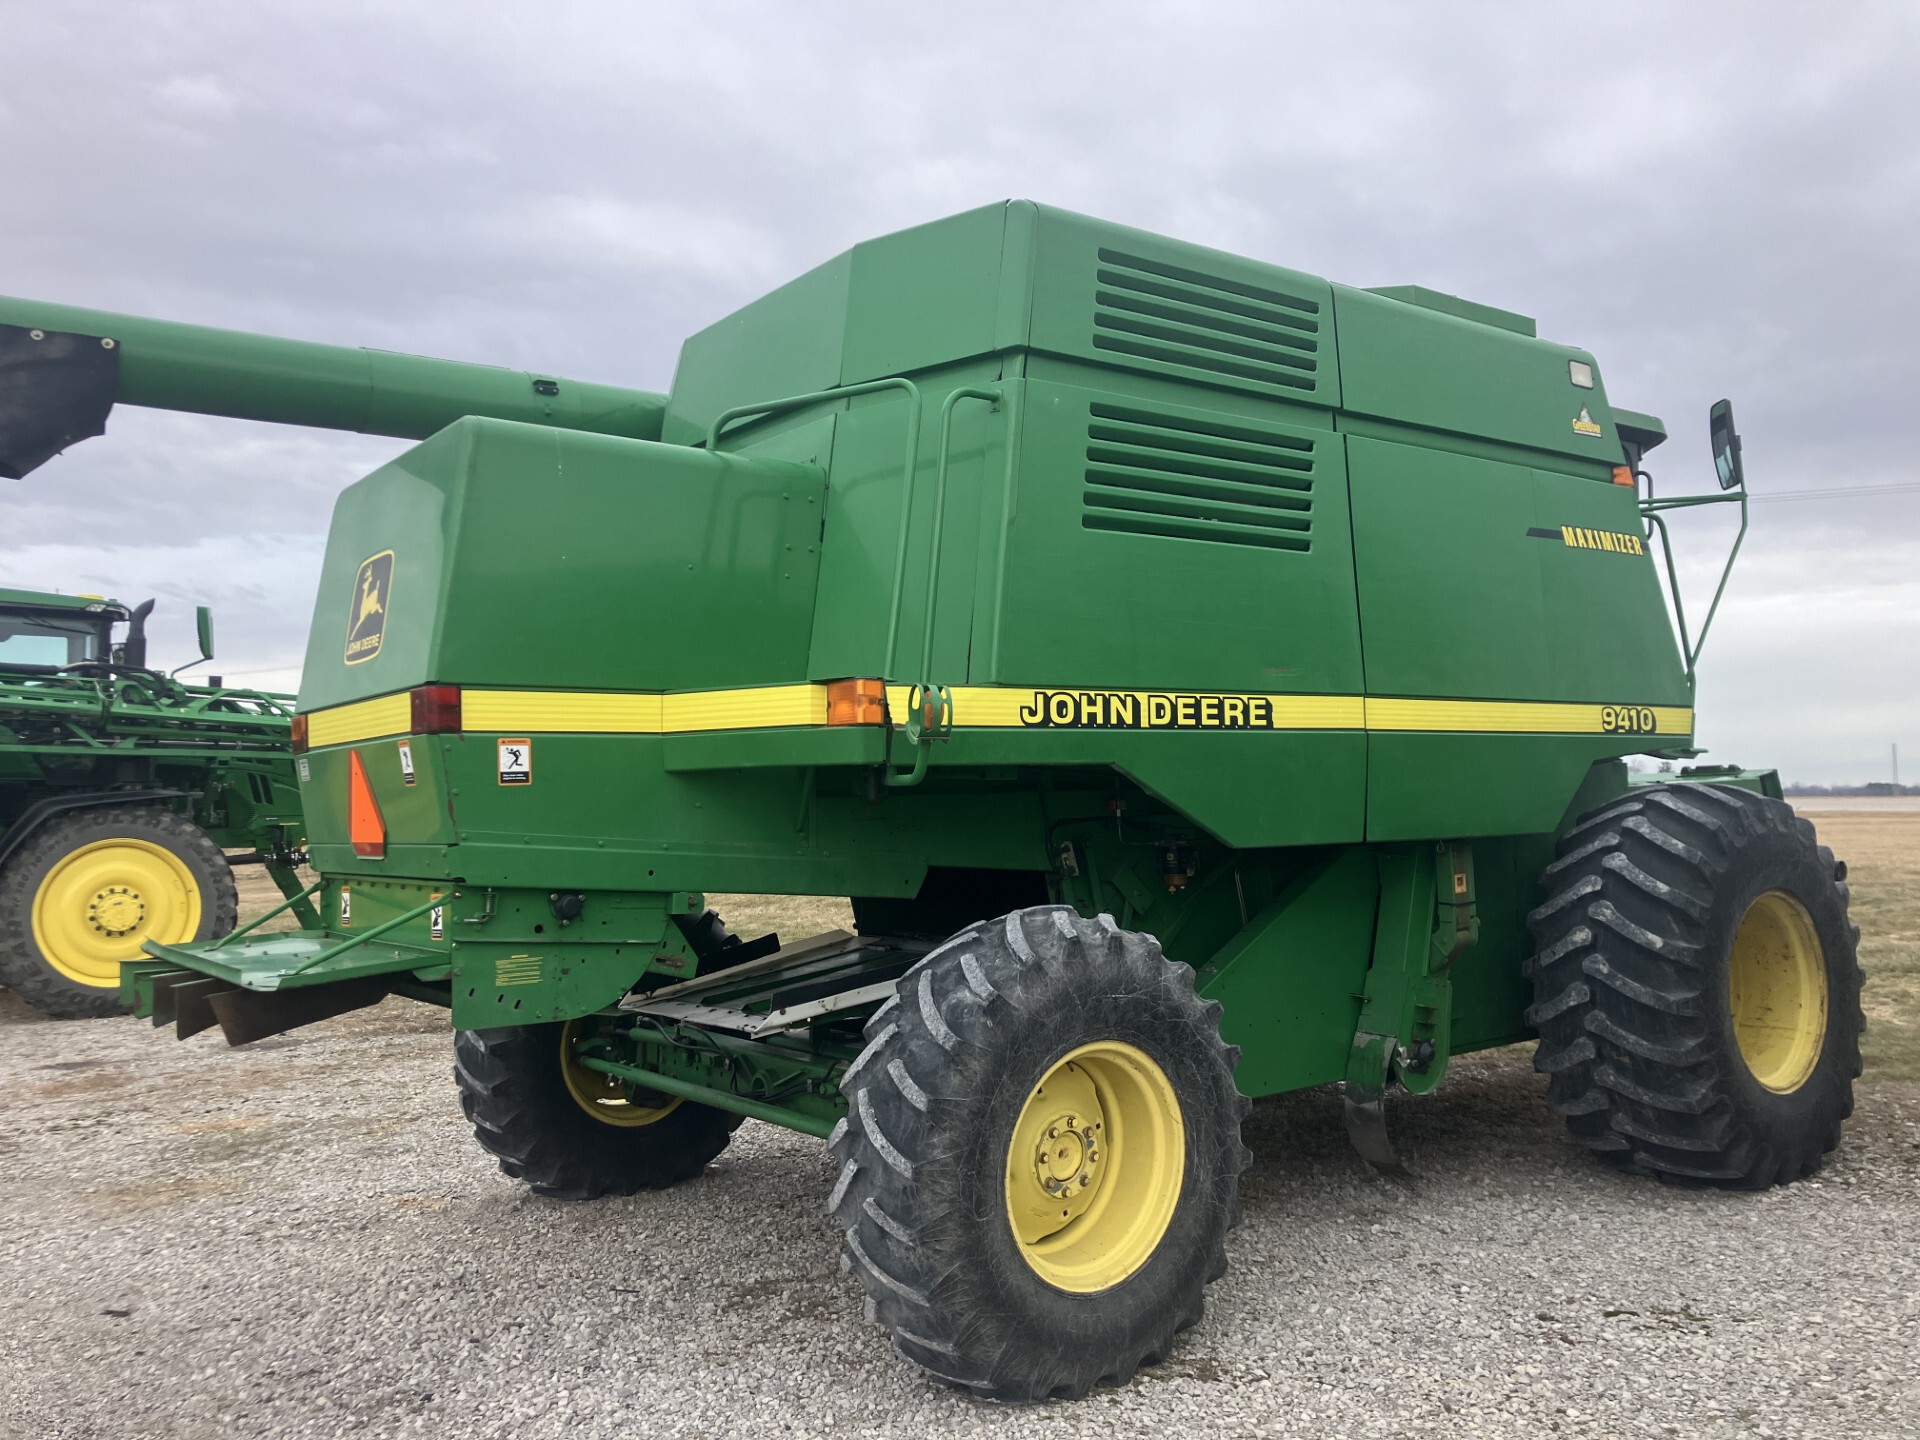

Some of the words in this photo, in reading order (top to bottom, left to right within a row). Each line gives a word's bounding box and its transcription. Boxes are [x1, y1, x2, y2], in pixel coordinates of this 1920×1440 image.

[1560, 525, 1644, 556] MAXIMIZER
[346, 641, 361, 656] JOHN
[360, 634, 380, 650] DEERE
[1021, 691, 1139, 727] JOHN
[1148, 694, 1272, 728] DEERE
[1602, 706, 1656, 732] 9410
